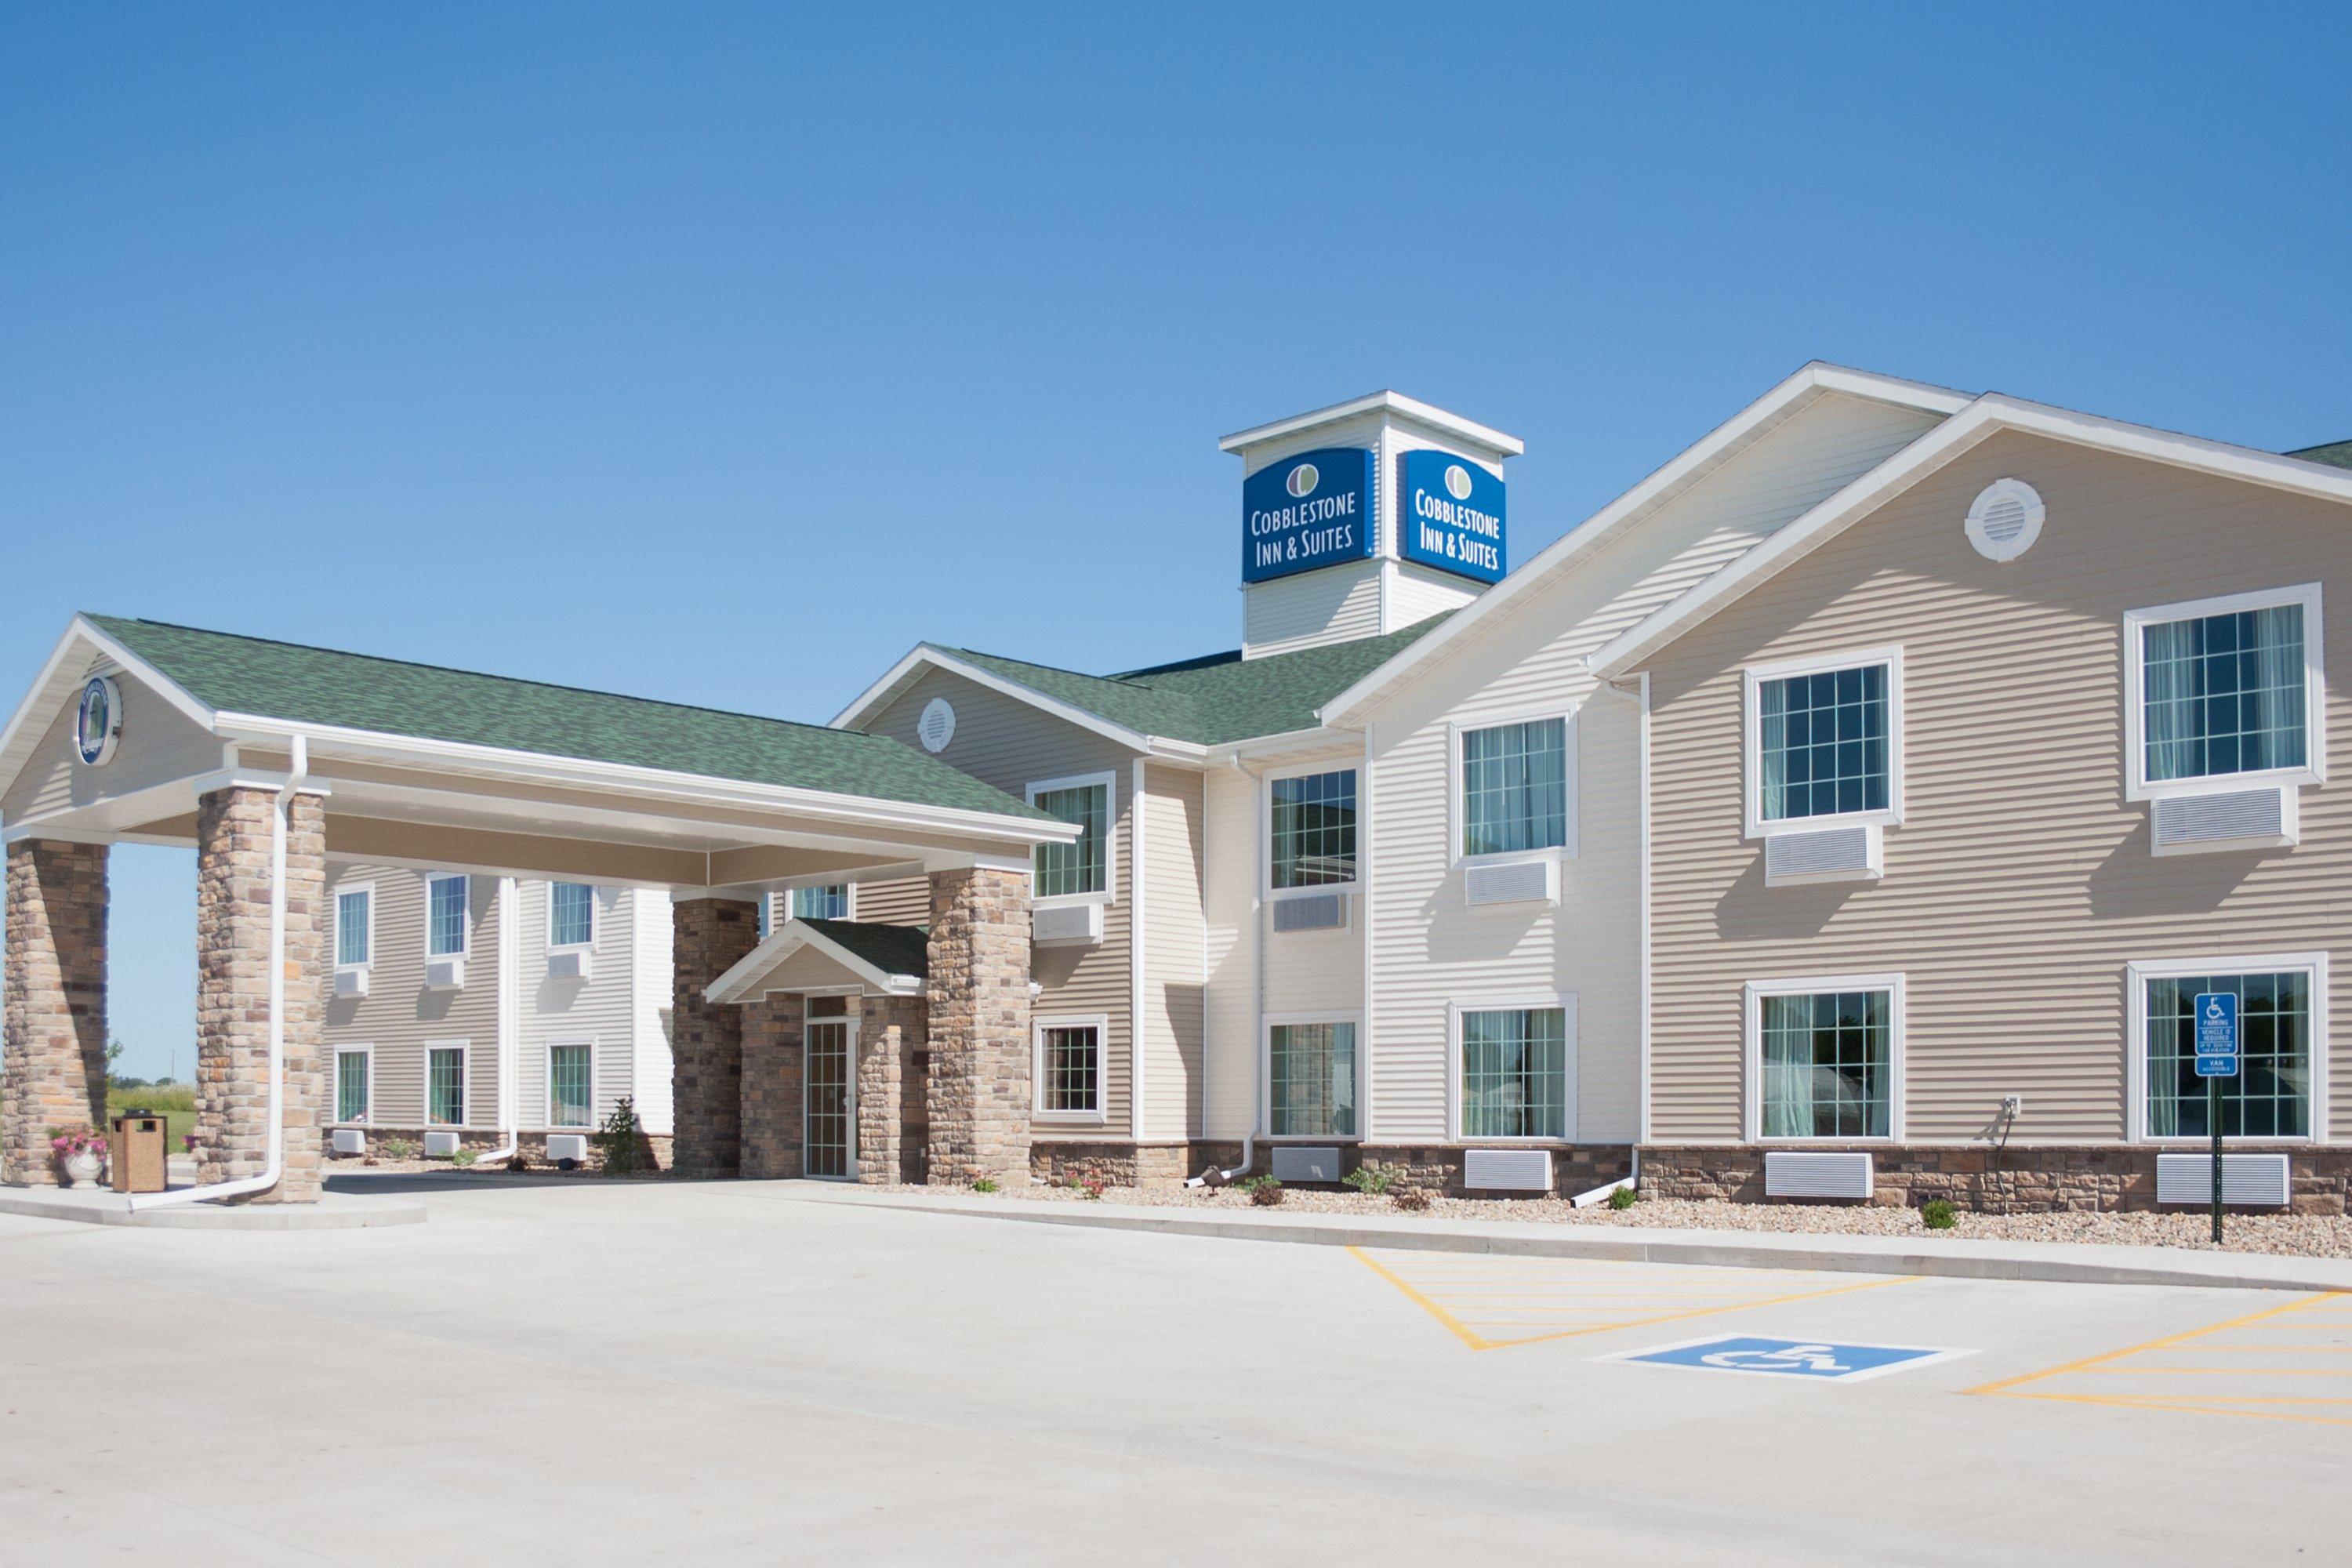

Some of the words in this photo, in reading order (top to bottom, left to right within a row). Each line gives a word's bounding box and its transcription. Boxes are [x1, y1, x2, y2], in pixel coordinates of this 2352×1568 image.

[1251, 492, 1355, 536] COBBLESTONE
[1415, 488, 1500, 539] COBBLESTONE
[1257, 541, 1282, 568] INN
[1287, 536, 1297, 560] &
[1301, 524, 1352, 557] SUITES
[1420, 521, 1443, 555] INN
[1446, 532, 1456, 558] &
[1458, 532, 1498, 571] SUITES
